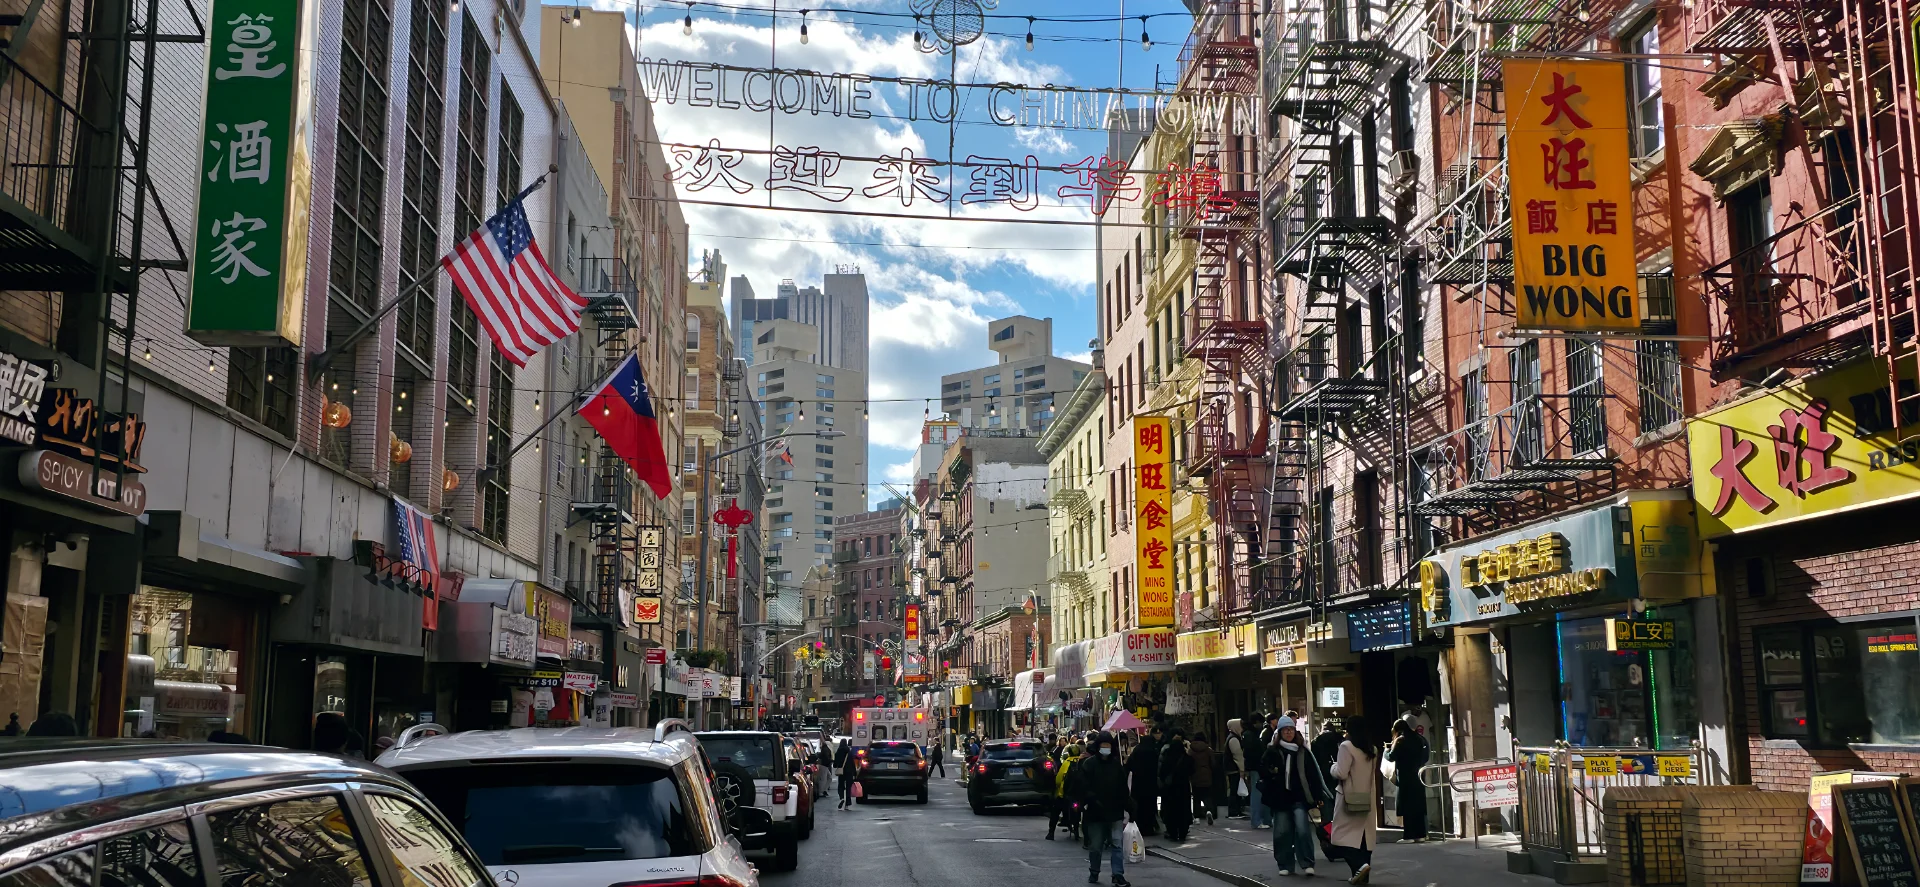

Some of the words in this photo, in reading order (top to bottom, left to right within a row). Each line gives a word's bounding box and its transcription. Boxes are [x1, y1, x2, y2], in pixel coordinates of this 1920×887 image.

[641, 57, 872, 119] WELCOME
[901, 75, 959, 124] TO
[988, 81, 1264, 137] CHINATOWN
[1540, 71, 1597, 191] 大旺
[663, 138, 1238, 219] 欢迎来到华埠
[1525, 199, 1617, 235] 飯店
[1542, 244, 1607, 277] BIG
[1523, 285, 1633, 319] WONG
[1710, 401, 1850, 516] 大旺
[42, 458, 84, 490] SPICY
[87, 474, 142, 509] OTOT
[1139, 423, 1169, 570] 明旺食堂
[1142, 591, 1168, 604] WONG
[1144, 576, 1165, 588] MING
[1127, 634, 1150, 651] GIFT
[1268, 627, 1286, 645] MOLLY
[1286, 625, 1298, 643] TEA
[1877, 644, 1889, 652] ROLL
[1889, 644, 1905, 652] SPRING
[1130, 655, 1136, 663] 4
[1139, 653, 1163, 663] T-SHIT
[1476, 774, 1497, 782] PRIVATE
[1815, 867, 1829, 878] $88
